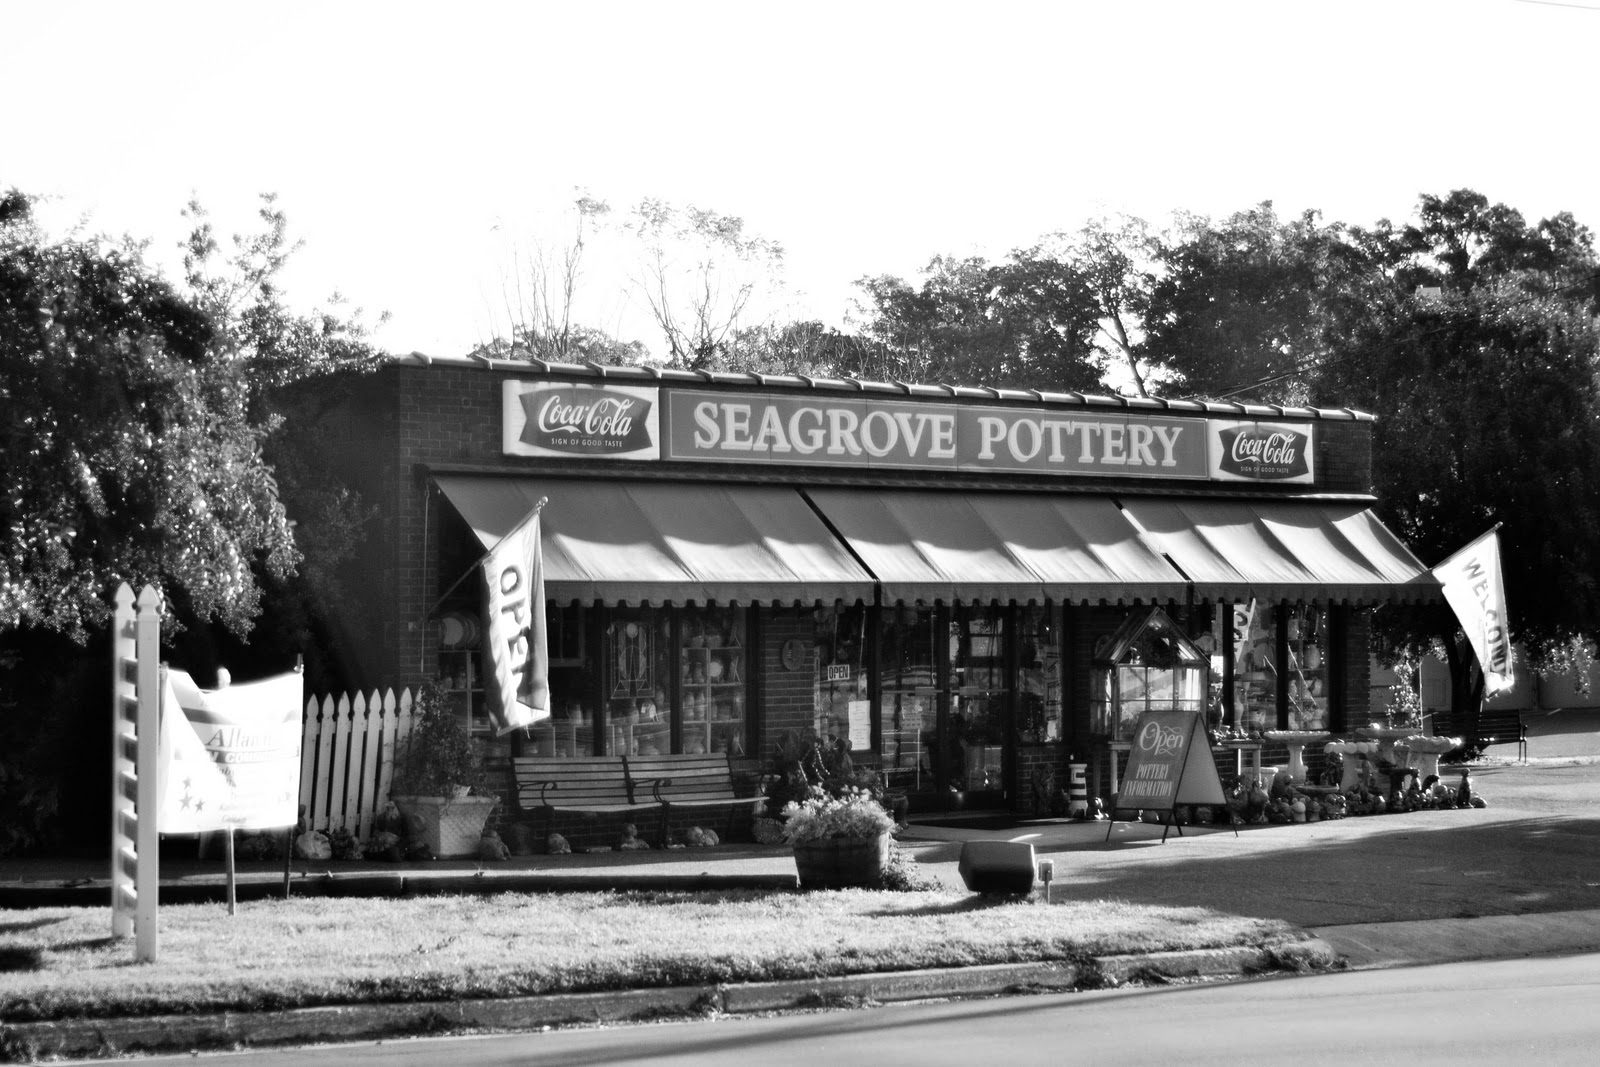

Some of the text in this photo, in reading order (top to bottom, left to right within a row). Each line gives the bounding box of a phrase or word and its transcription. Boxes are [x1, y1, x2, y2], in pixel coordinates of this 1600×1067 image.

[538, 395, 634, 436] Coca-Cola
[694, 401, 1183, 467] SEAGROVE POTTERY
[1231, 431, 1297, 464] Coca-Cola
[1462, 557, 1507, 680] WELCOM
[829, 666, 849, 680] OPEN
[1140, 721, 1184, 756] Open
[1136, 763, 1169, 779] POTTERY
[1124, 781, 1172, 797] INFORMATION
